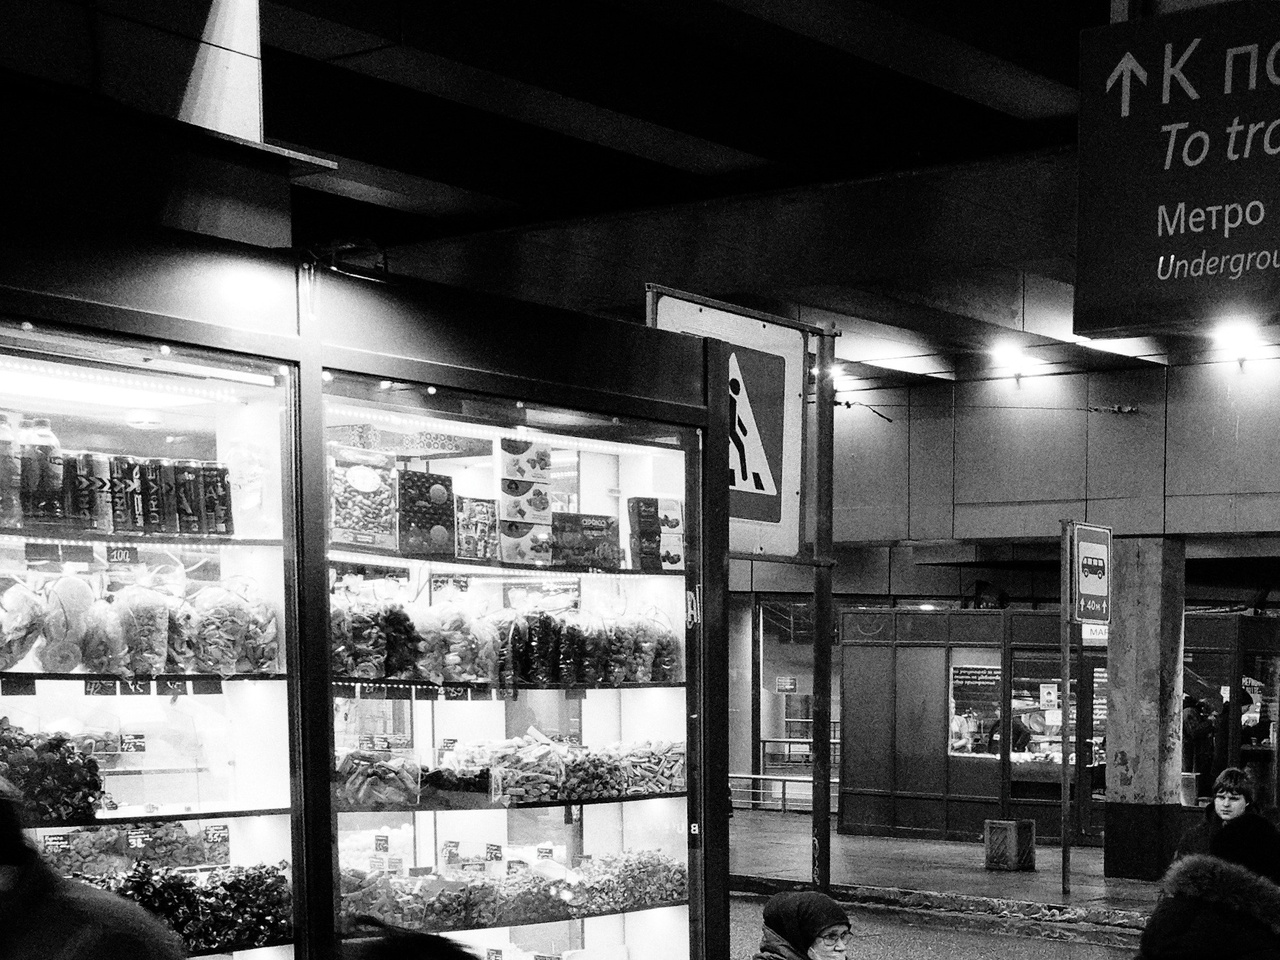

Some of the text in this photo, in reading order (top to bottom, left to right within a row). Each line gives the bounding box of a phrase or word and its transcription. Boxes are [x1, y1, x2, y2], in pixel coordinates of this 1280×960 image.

[1161, 37, 1201, 103] К
[1160, 121, 1210, 170] To
[1157, 200, 1265, 238] Метро
